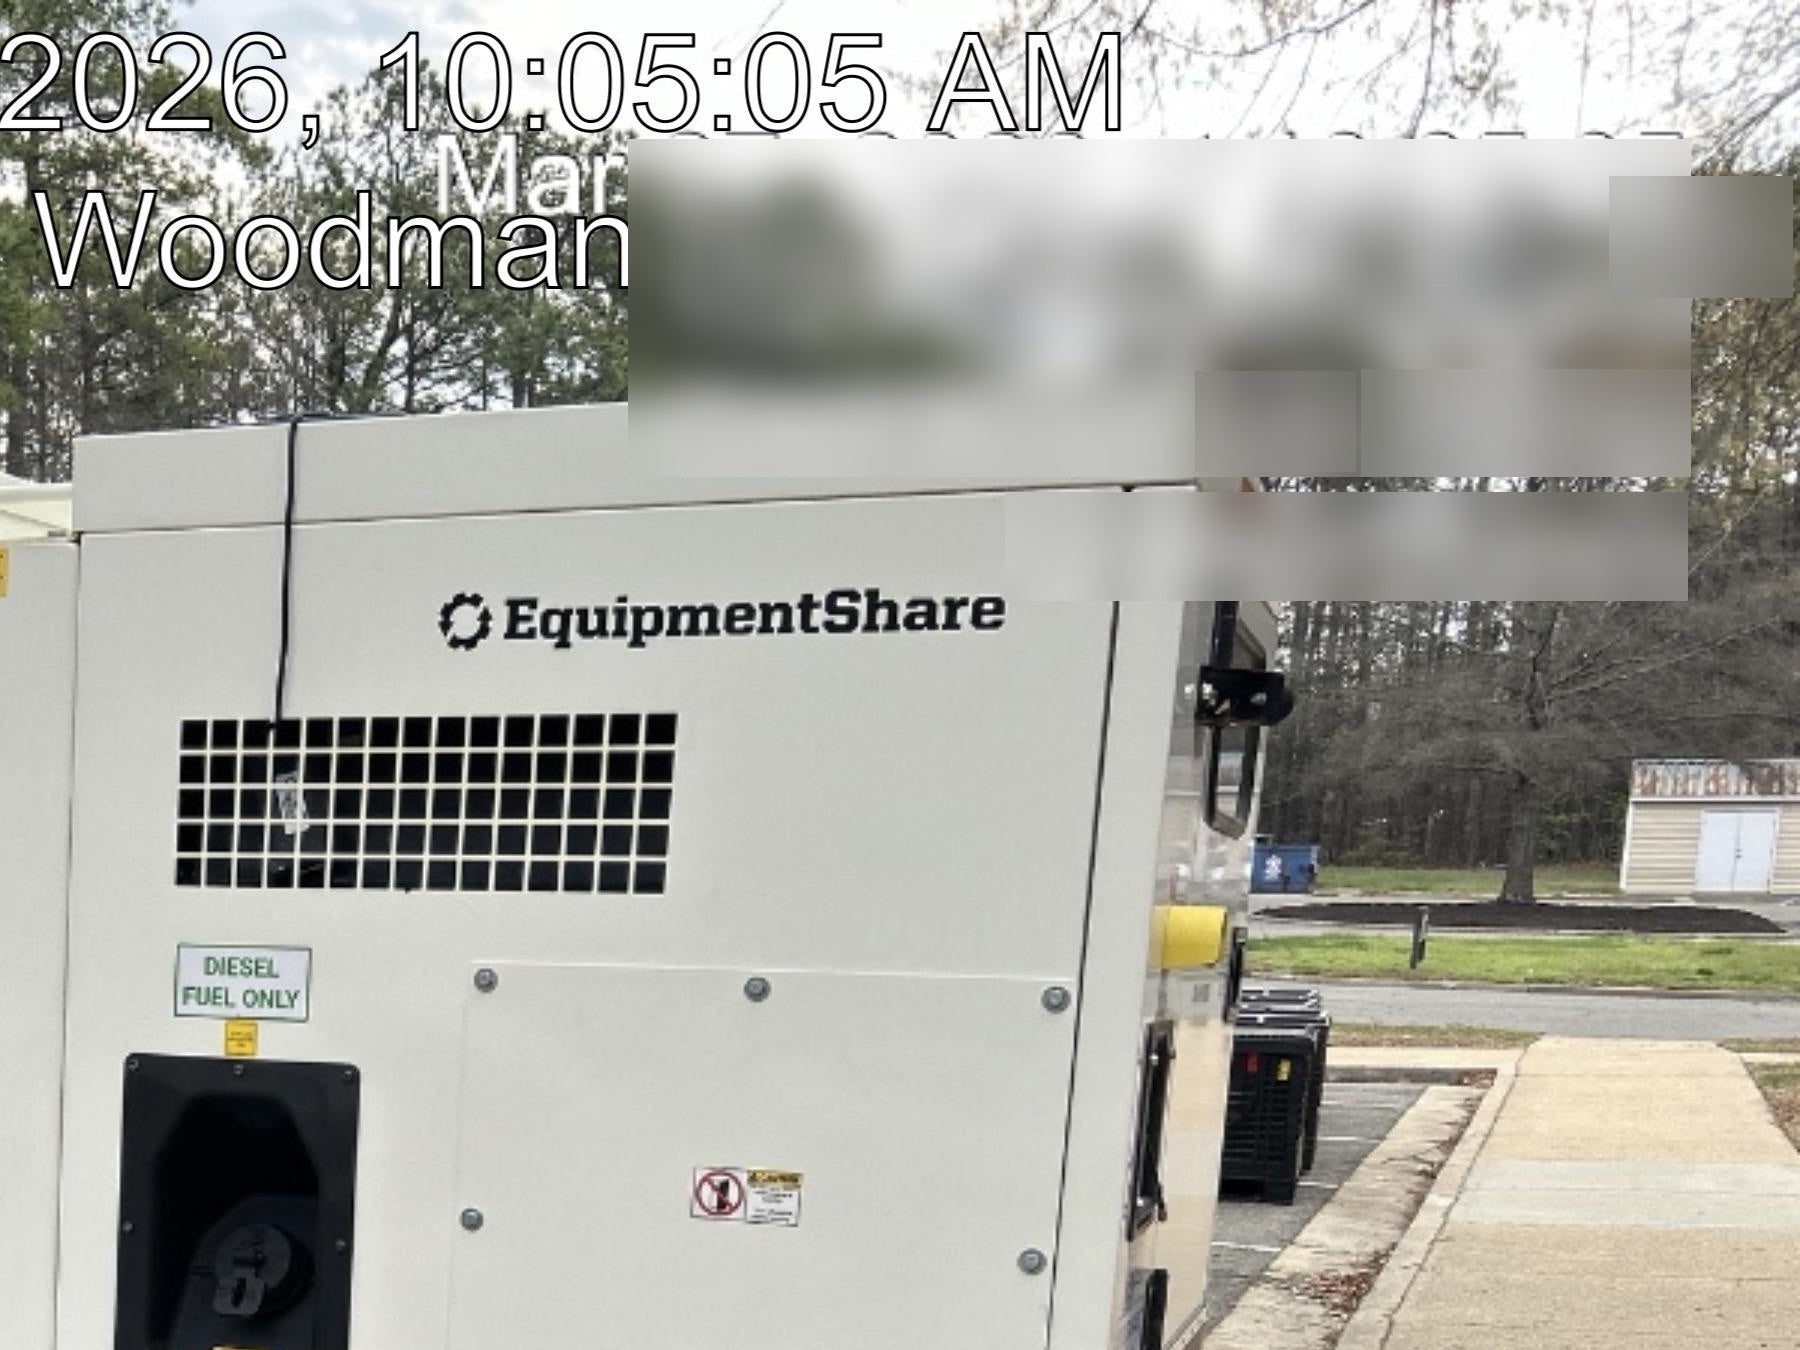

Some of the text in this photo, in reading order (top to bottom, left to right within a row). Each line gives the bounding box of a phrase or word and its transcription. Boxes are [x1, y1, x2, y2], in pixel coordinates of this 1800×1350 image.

[502, 588, 1007, 649] EquipmentShare
[203, 956, 280, 979] DIESEL
[182, 986, 301, 1010] FUEL ONLY
